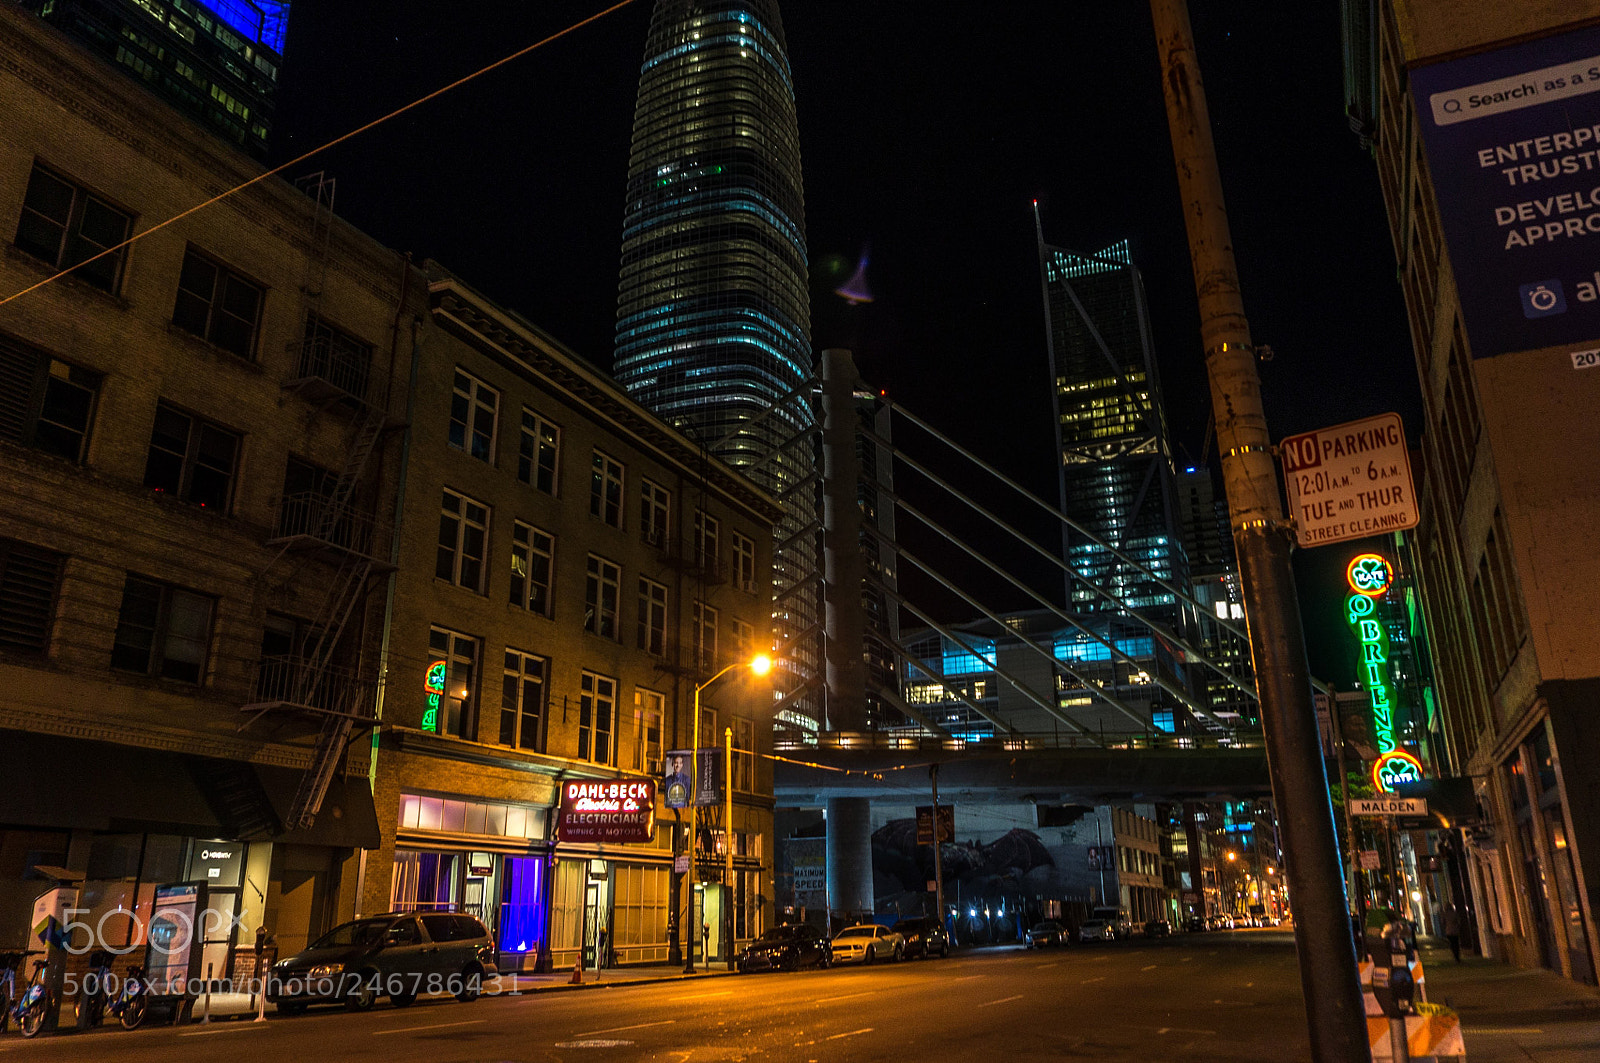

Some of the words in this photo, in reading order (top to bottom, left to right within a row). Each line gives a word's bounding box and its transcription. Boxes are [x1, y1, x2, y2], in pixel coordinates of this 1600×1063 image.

[1469, 84, 1535, 108] Search
[1544, 78, 1566, 91] as
[1571, 74, 1583, 85] a
[1502, 149, 1600, 186] TRUST
[1285, 437, 1317, 469] NO
[1322, 425, 1399, 460] PARKING
[1296, 471, 1330, 496] 12:01
[1367, 460, 1378, 480] 6
[1301, 500, 1336, 521] TUE
[1339, 499, 1355, 510] AND
[1357, 486, 1404, 510] THUR
[1305, 524, 1346, 541] STREET
[1349, 512, 1407, 533] CLEANING
[565, 813, 647, 825] ELECTRICIANS
[1361, 802, 1415, 812] MALDEN
[605, 826, 642, 837] MOTORS
[794, 869, 824, 878] MAXIMUM
[795, 880, 824, 889] SPEED
